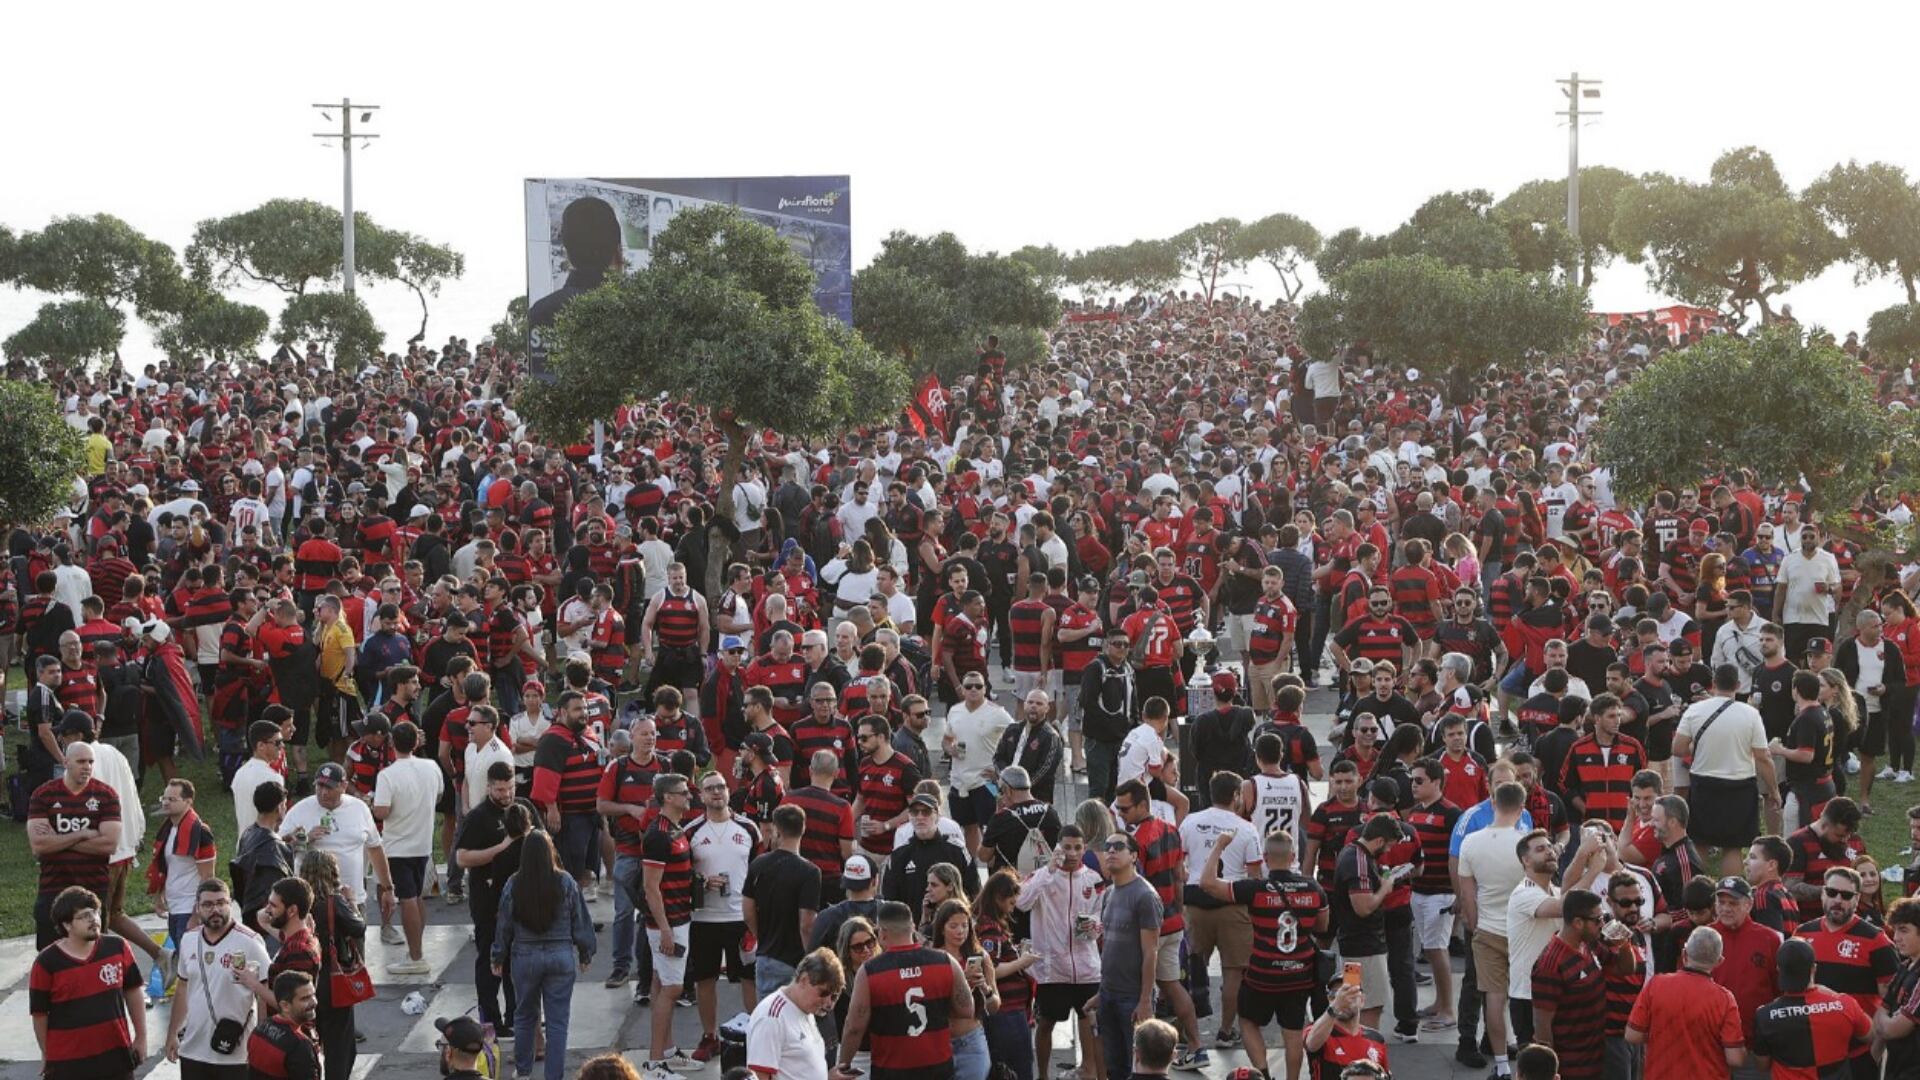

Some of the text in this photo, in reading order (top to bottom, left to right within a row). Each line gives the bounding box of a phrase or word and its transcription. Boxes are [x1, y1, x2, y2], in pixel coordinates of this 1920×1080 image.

[56, 813, 91, 832] bs2
[1264, 808, 1293, 838] 22
[1277, 911, 1298, 953] 8
[900, 966, 922, 979] BELO
[905, 986, 928, 1037] 5
[1769, 1000, 1844, 1020] PETROBRAS
